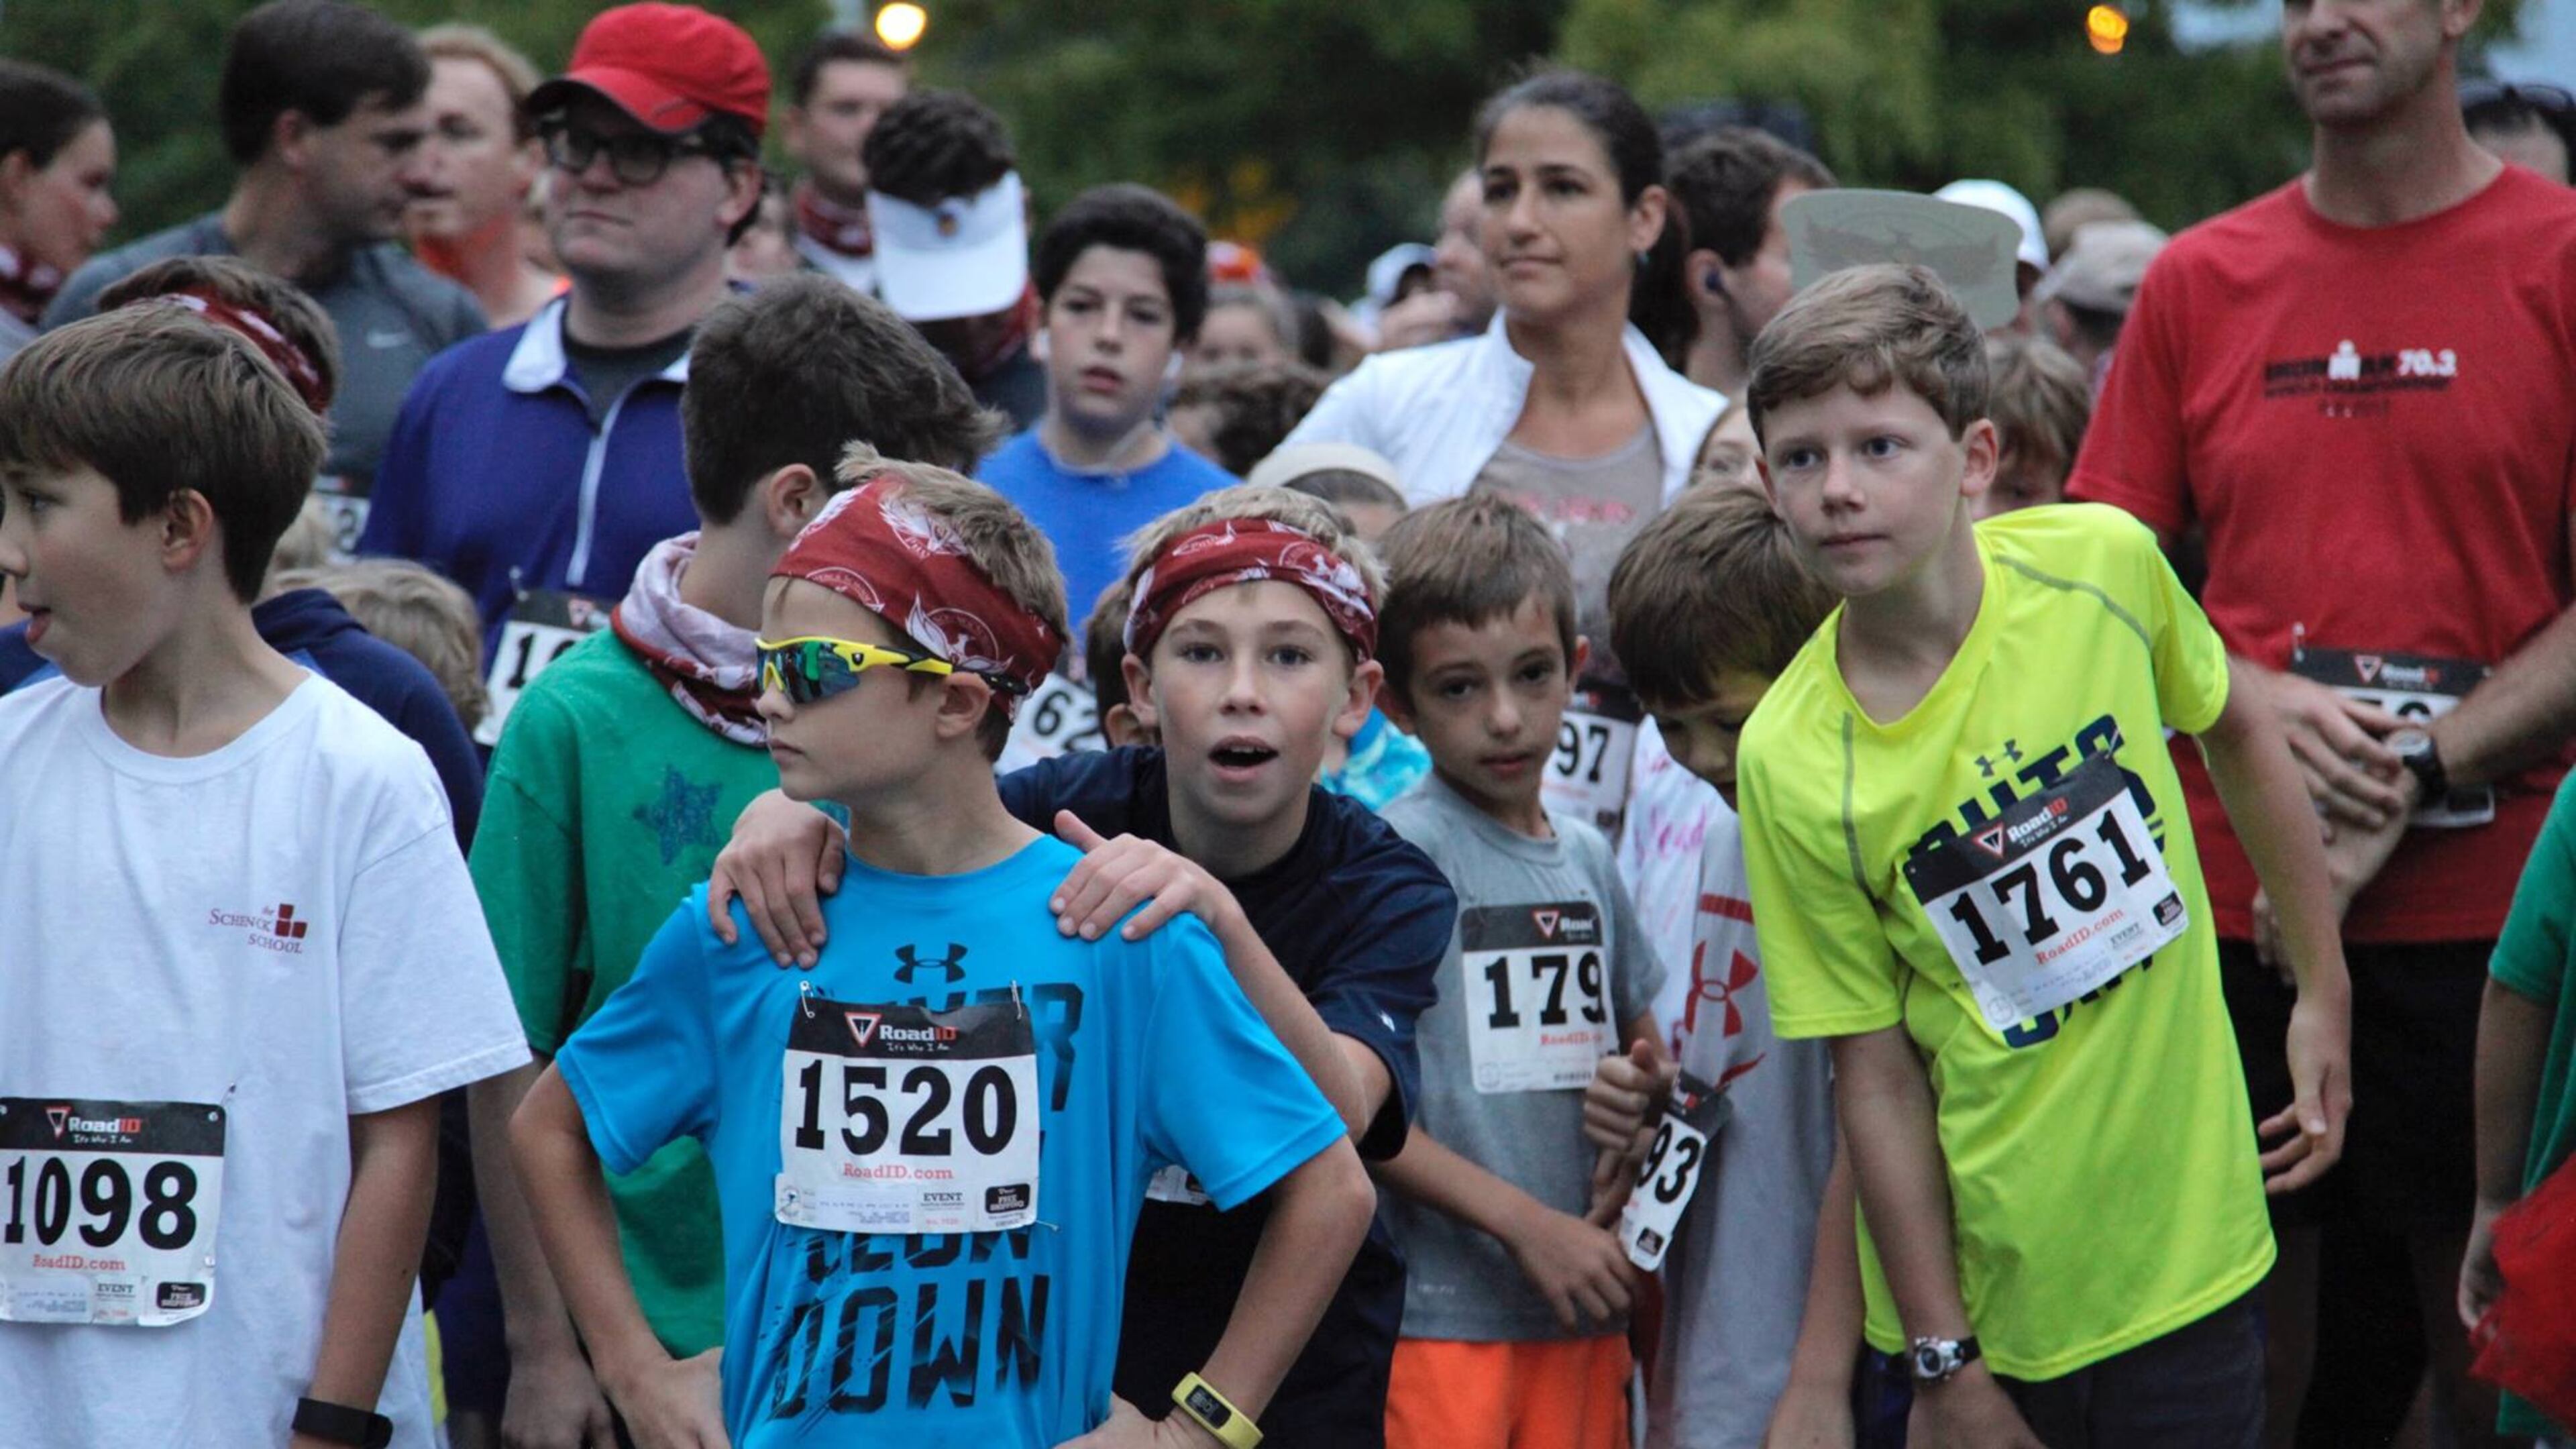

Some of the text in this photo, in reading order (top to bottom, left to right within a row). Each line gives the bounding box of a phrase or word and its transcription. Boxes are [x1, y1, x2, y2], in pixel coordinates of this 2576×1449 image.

[1556, 722, 1609, 783] 97
[2006, 797, 2068, 843] RoadID
[1949, 809, 2151, 967] 1761
[247, 933, 303, 954] SCHOOL
[2035, 908, 2125, 966] RoadID.com
[879, 1024, 957, 1041] RoadID
[927, 1042, 934, 1052] I
[68, 1116, 141, 1133] RoadID
[796, 1059, 1017, 1157] 1520
[843, 1163, 954, 1179] RoadID.com
[1635, 1121, 1701, 1203] 93
[4, 1155, 197, 1250] 1098
[924, 1192, 963, 1201] EVENT
[32, 1254, 126, 1271] RoadID.com
[97, 1283, 134, 1294] EVENT
[770, 1273, 1051, 1419] DOWN
